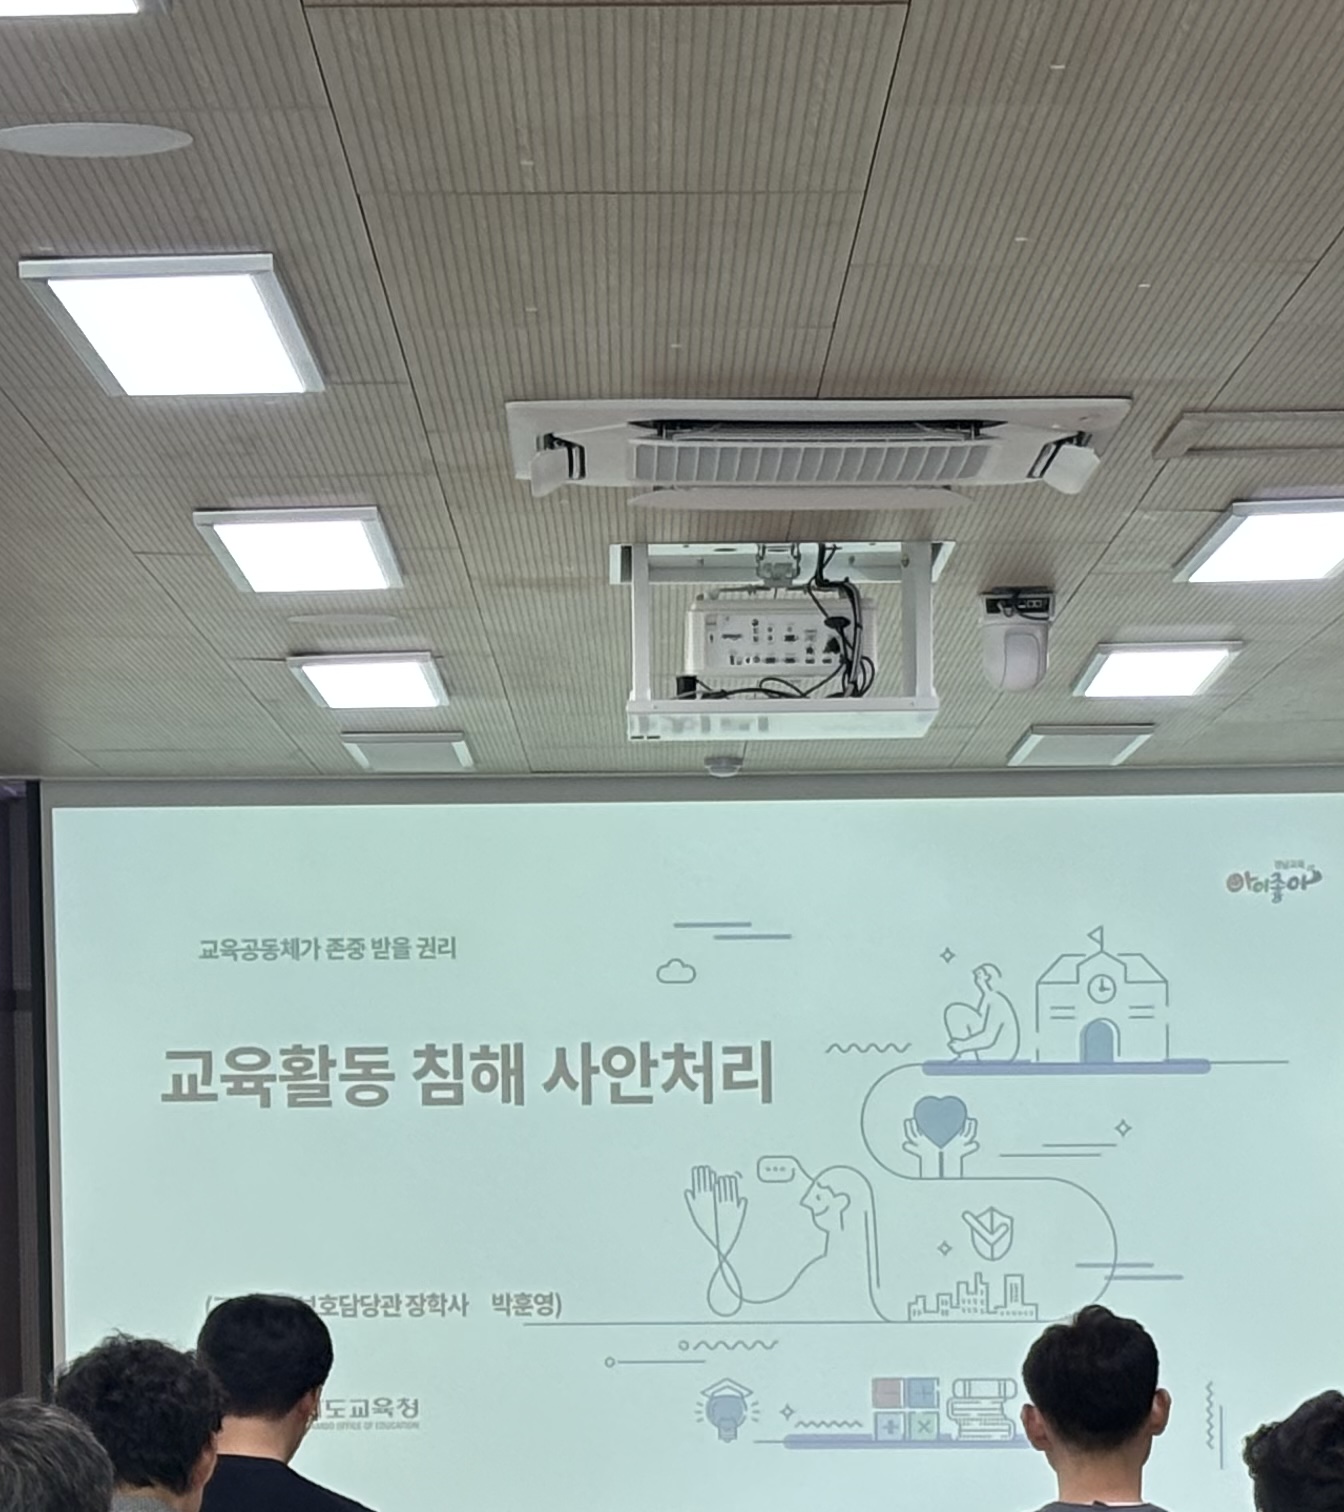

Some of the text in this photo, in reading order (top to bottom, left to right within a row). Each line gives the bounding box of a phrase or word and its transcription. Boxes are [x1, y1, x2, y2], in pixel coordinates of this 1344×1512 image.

[1225, 870, 1323, 904] 아이좋아
[198, 936, 457, 962] 교육공동체가 존중 받을 권리
[160, 1040, 773, 1108] 교육활동 침해 사안처리
[405, 1292, 470, 1318] 장학사
[491, 1291, 563, 1319] 박훈영)
